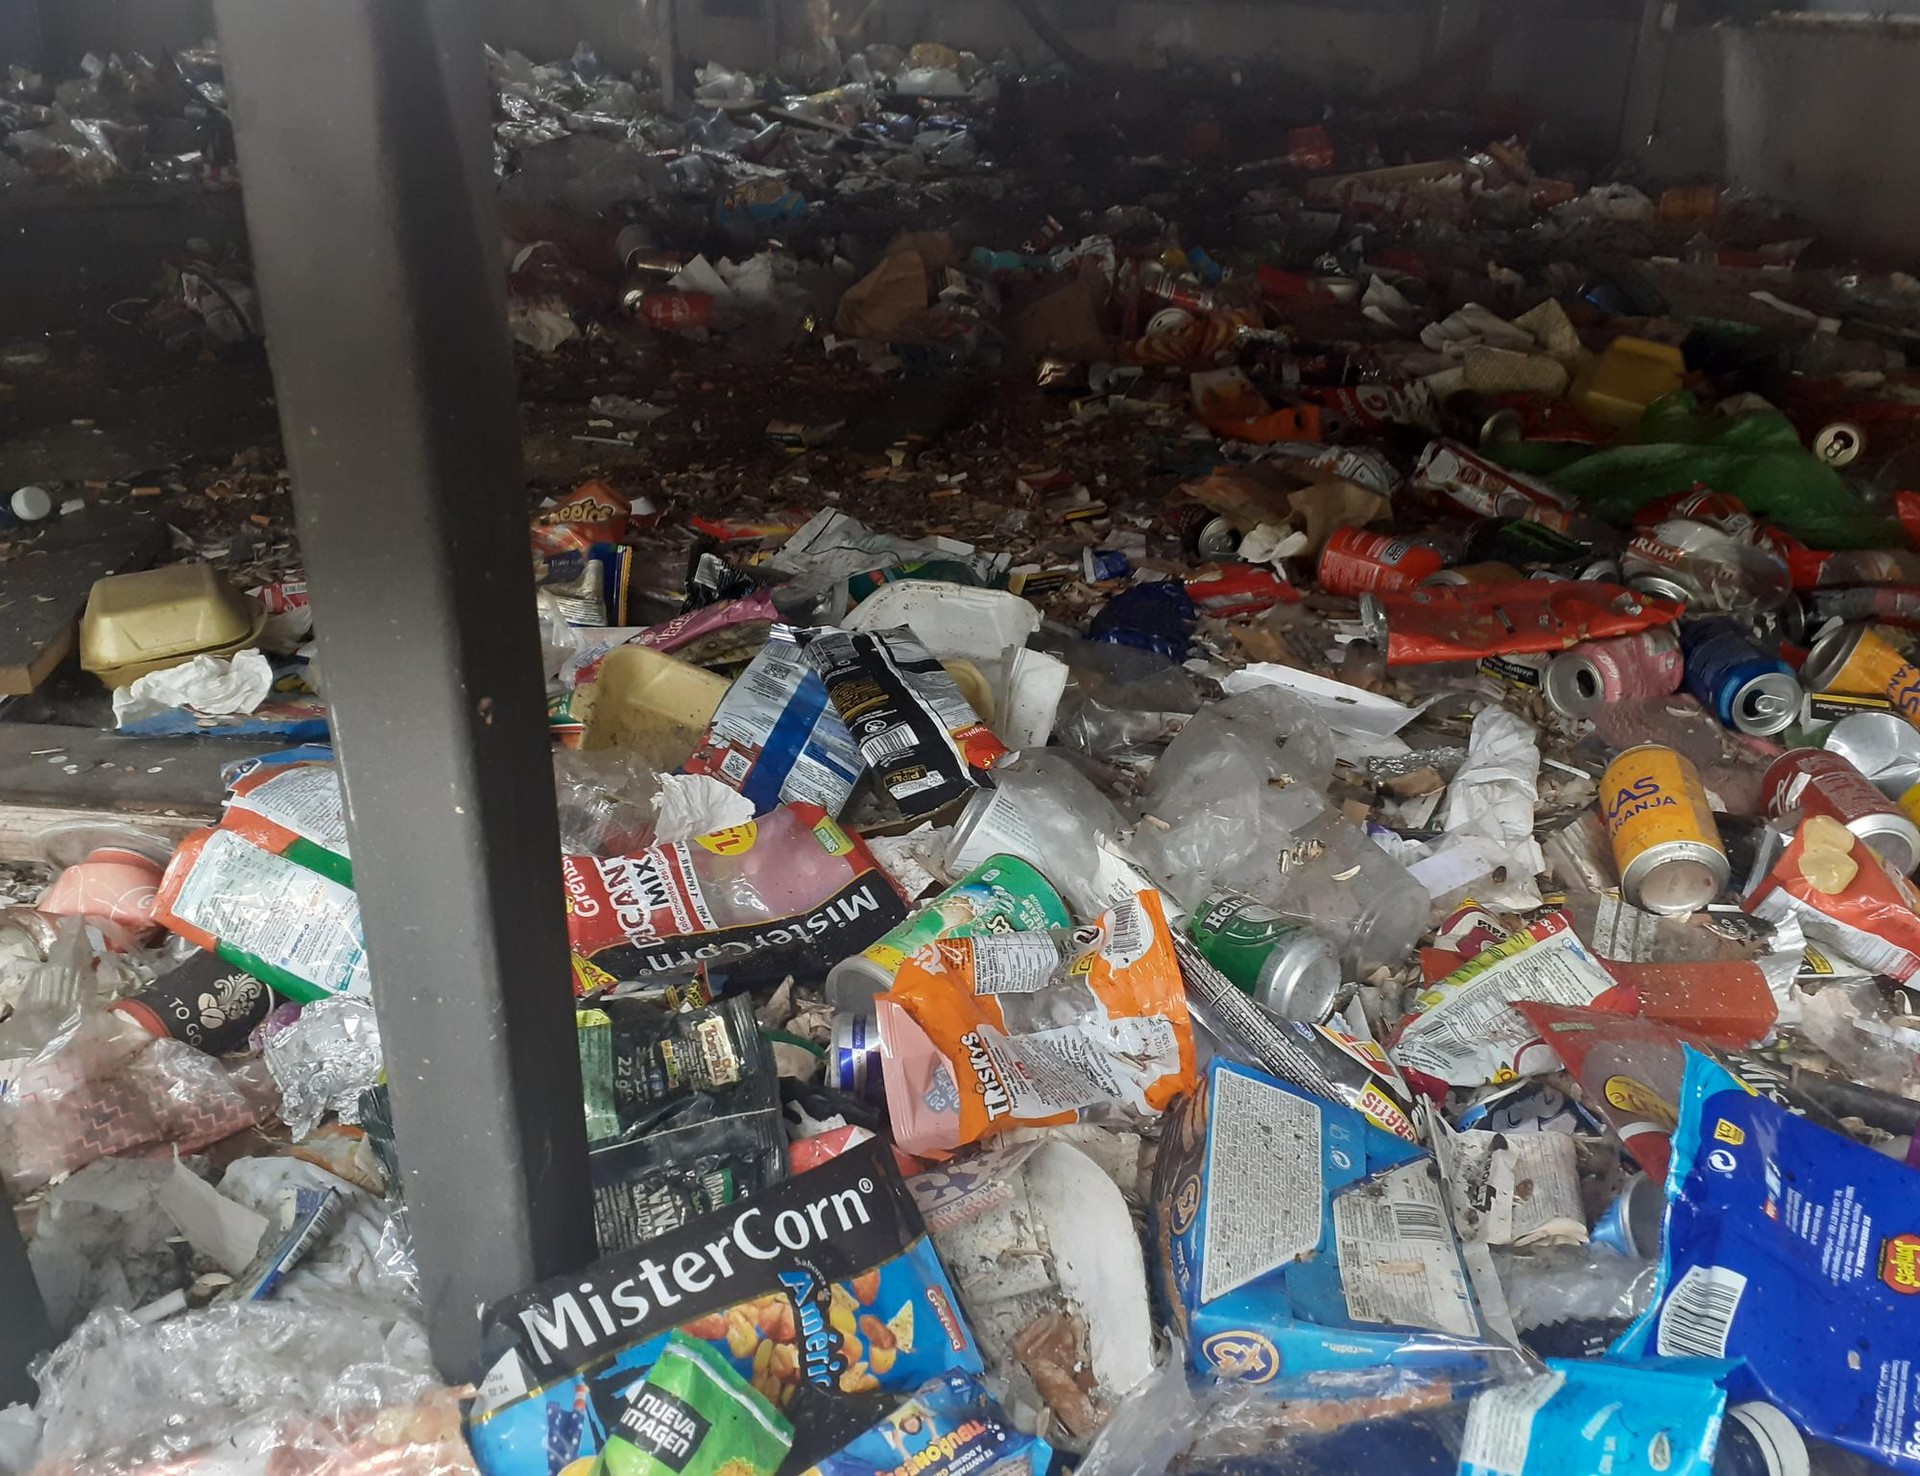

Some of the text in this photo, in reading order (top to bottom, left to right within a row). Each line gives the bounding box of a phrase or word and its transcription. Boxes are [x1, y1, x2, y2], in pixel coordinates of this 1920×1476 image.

[632, 856, 670, 907] MIX
[647, 885, 881, 972] MisterCorn
[168, 996, 204, 1047] TO GO
[1360, 1090, 1415, 1142] GRATIS
[518, 1188, 872, 1366] MisterCorn
[925, 1288, 962, 1351] Grefusa
[619, 1407, 691, 1459] IMAGEN
[637, 1392, 697, 1440] NUEVA
